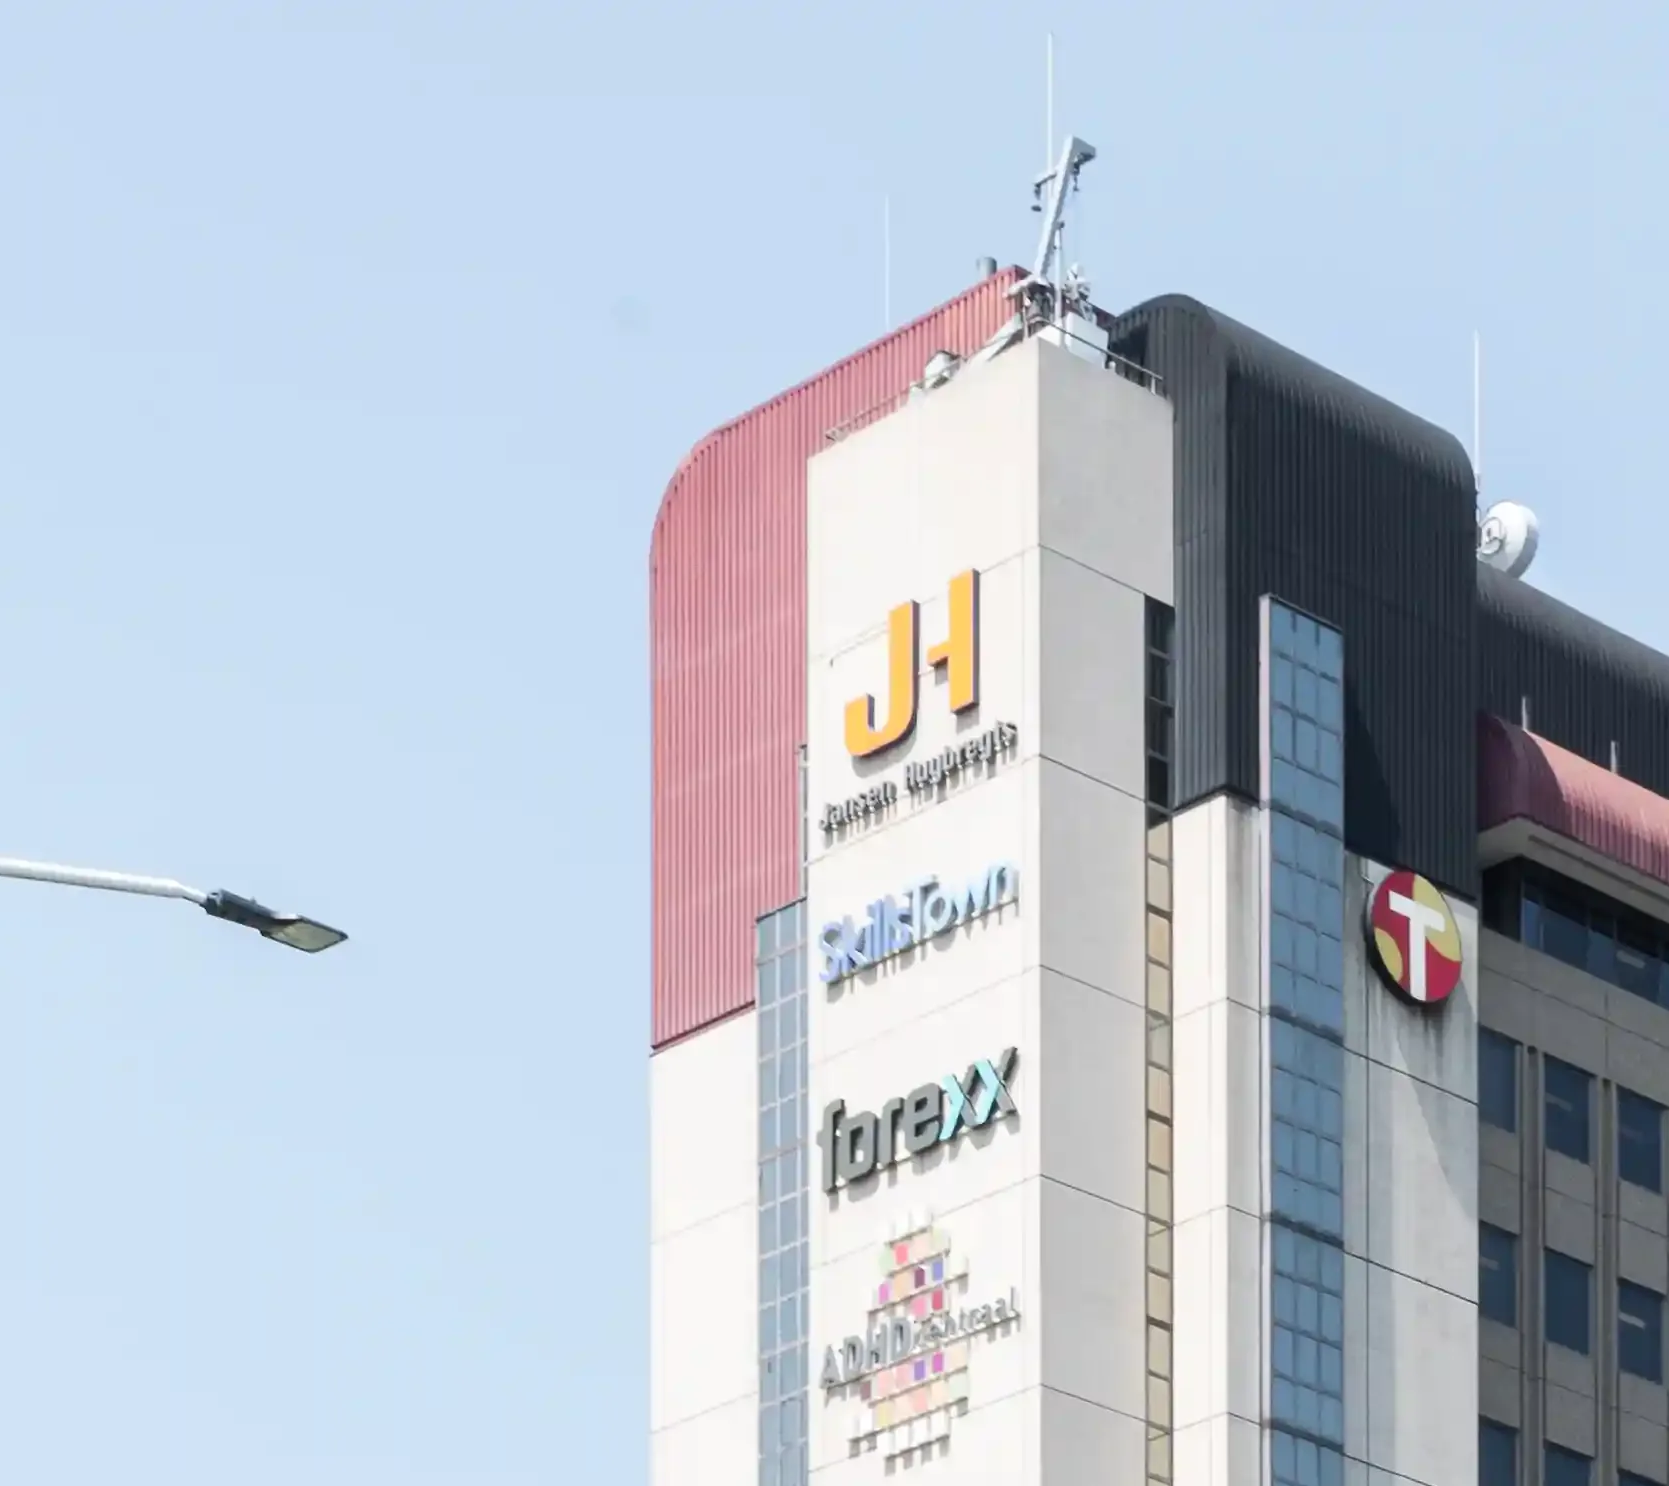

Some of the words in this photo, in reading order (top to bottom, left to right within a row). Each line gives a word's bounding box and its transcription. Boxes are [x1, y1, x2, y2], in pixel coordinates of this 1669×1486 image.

[818, 780, 898, 831] Jansen
[819, 860, 1020, 985] SkillsTown
[816, 1046, 1020, 1194] forexx
